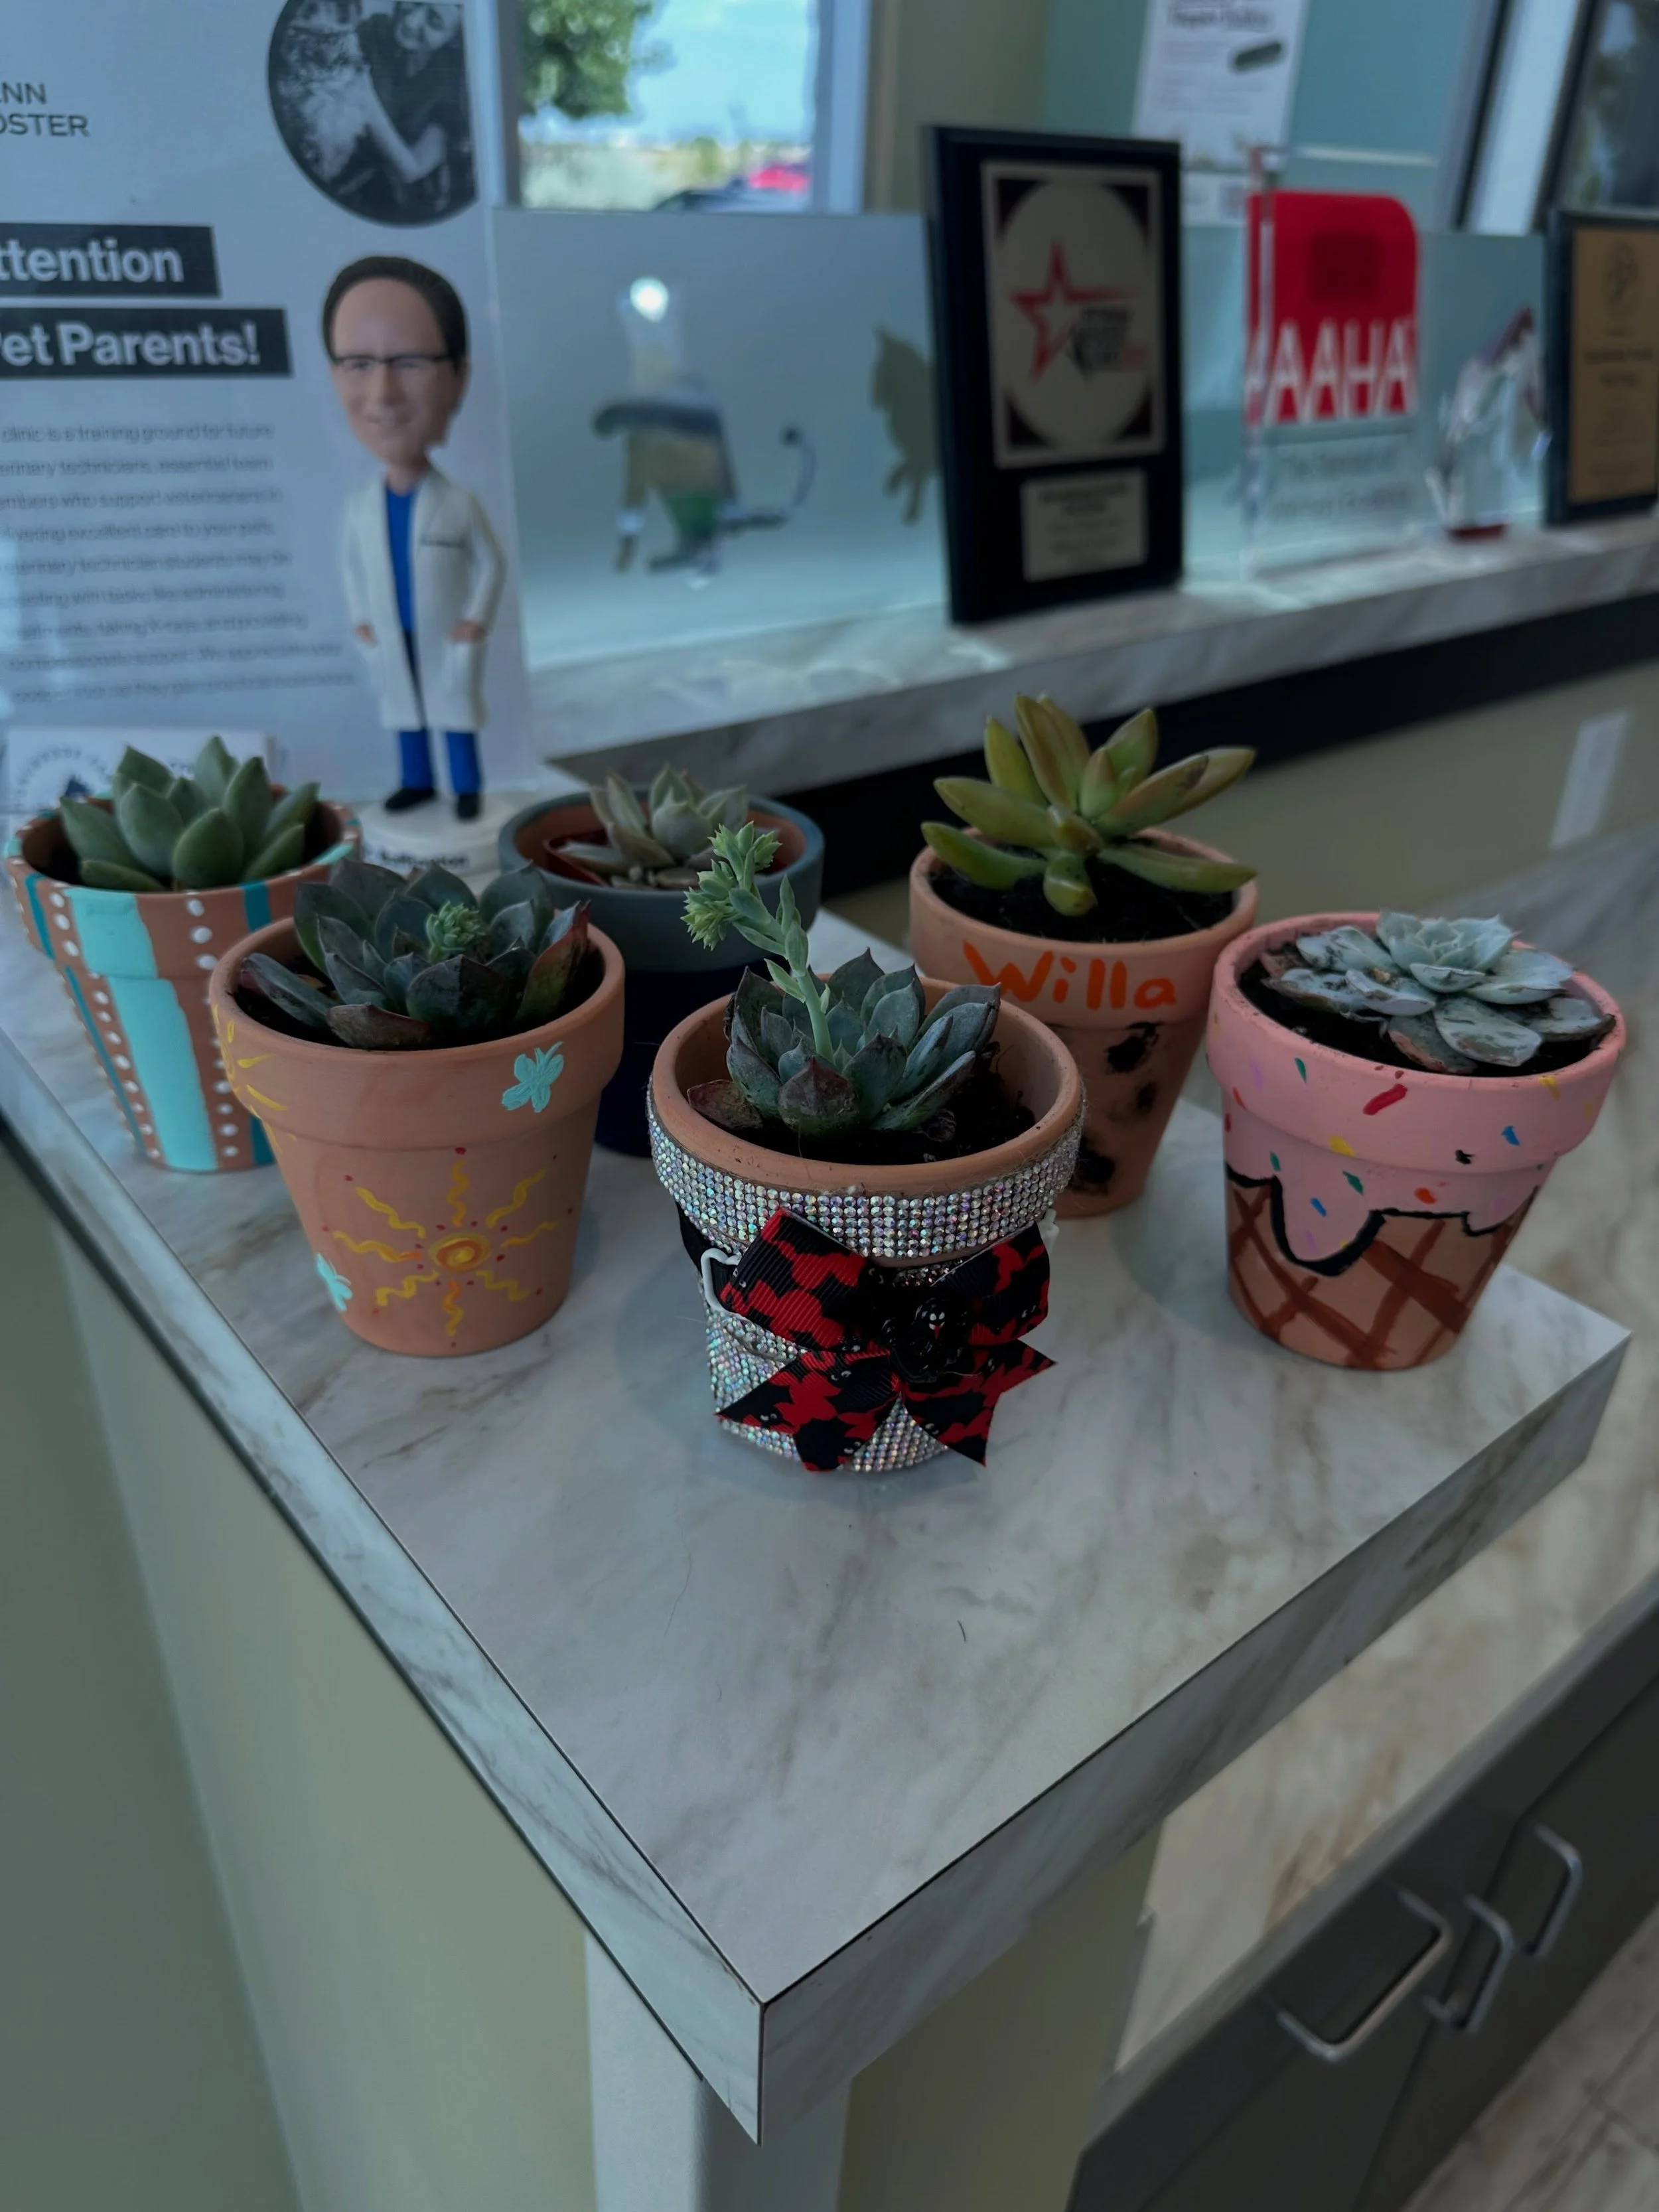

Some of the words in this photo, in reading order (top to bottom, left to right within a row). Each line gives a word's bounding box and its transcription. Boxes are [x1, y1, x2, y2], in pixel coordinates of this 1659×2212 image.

[0, 82, 46, 105] NN
[0, 321, 55, 366] et
[56, 319, 260, 366] Parents!
[1263, 316, 1416, 428] AAHA
[962, 938, 1177, 1011] Willa
